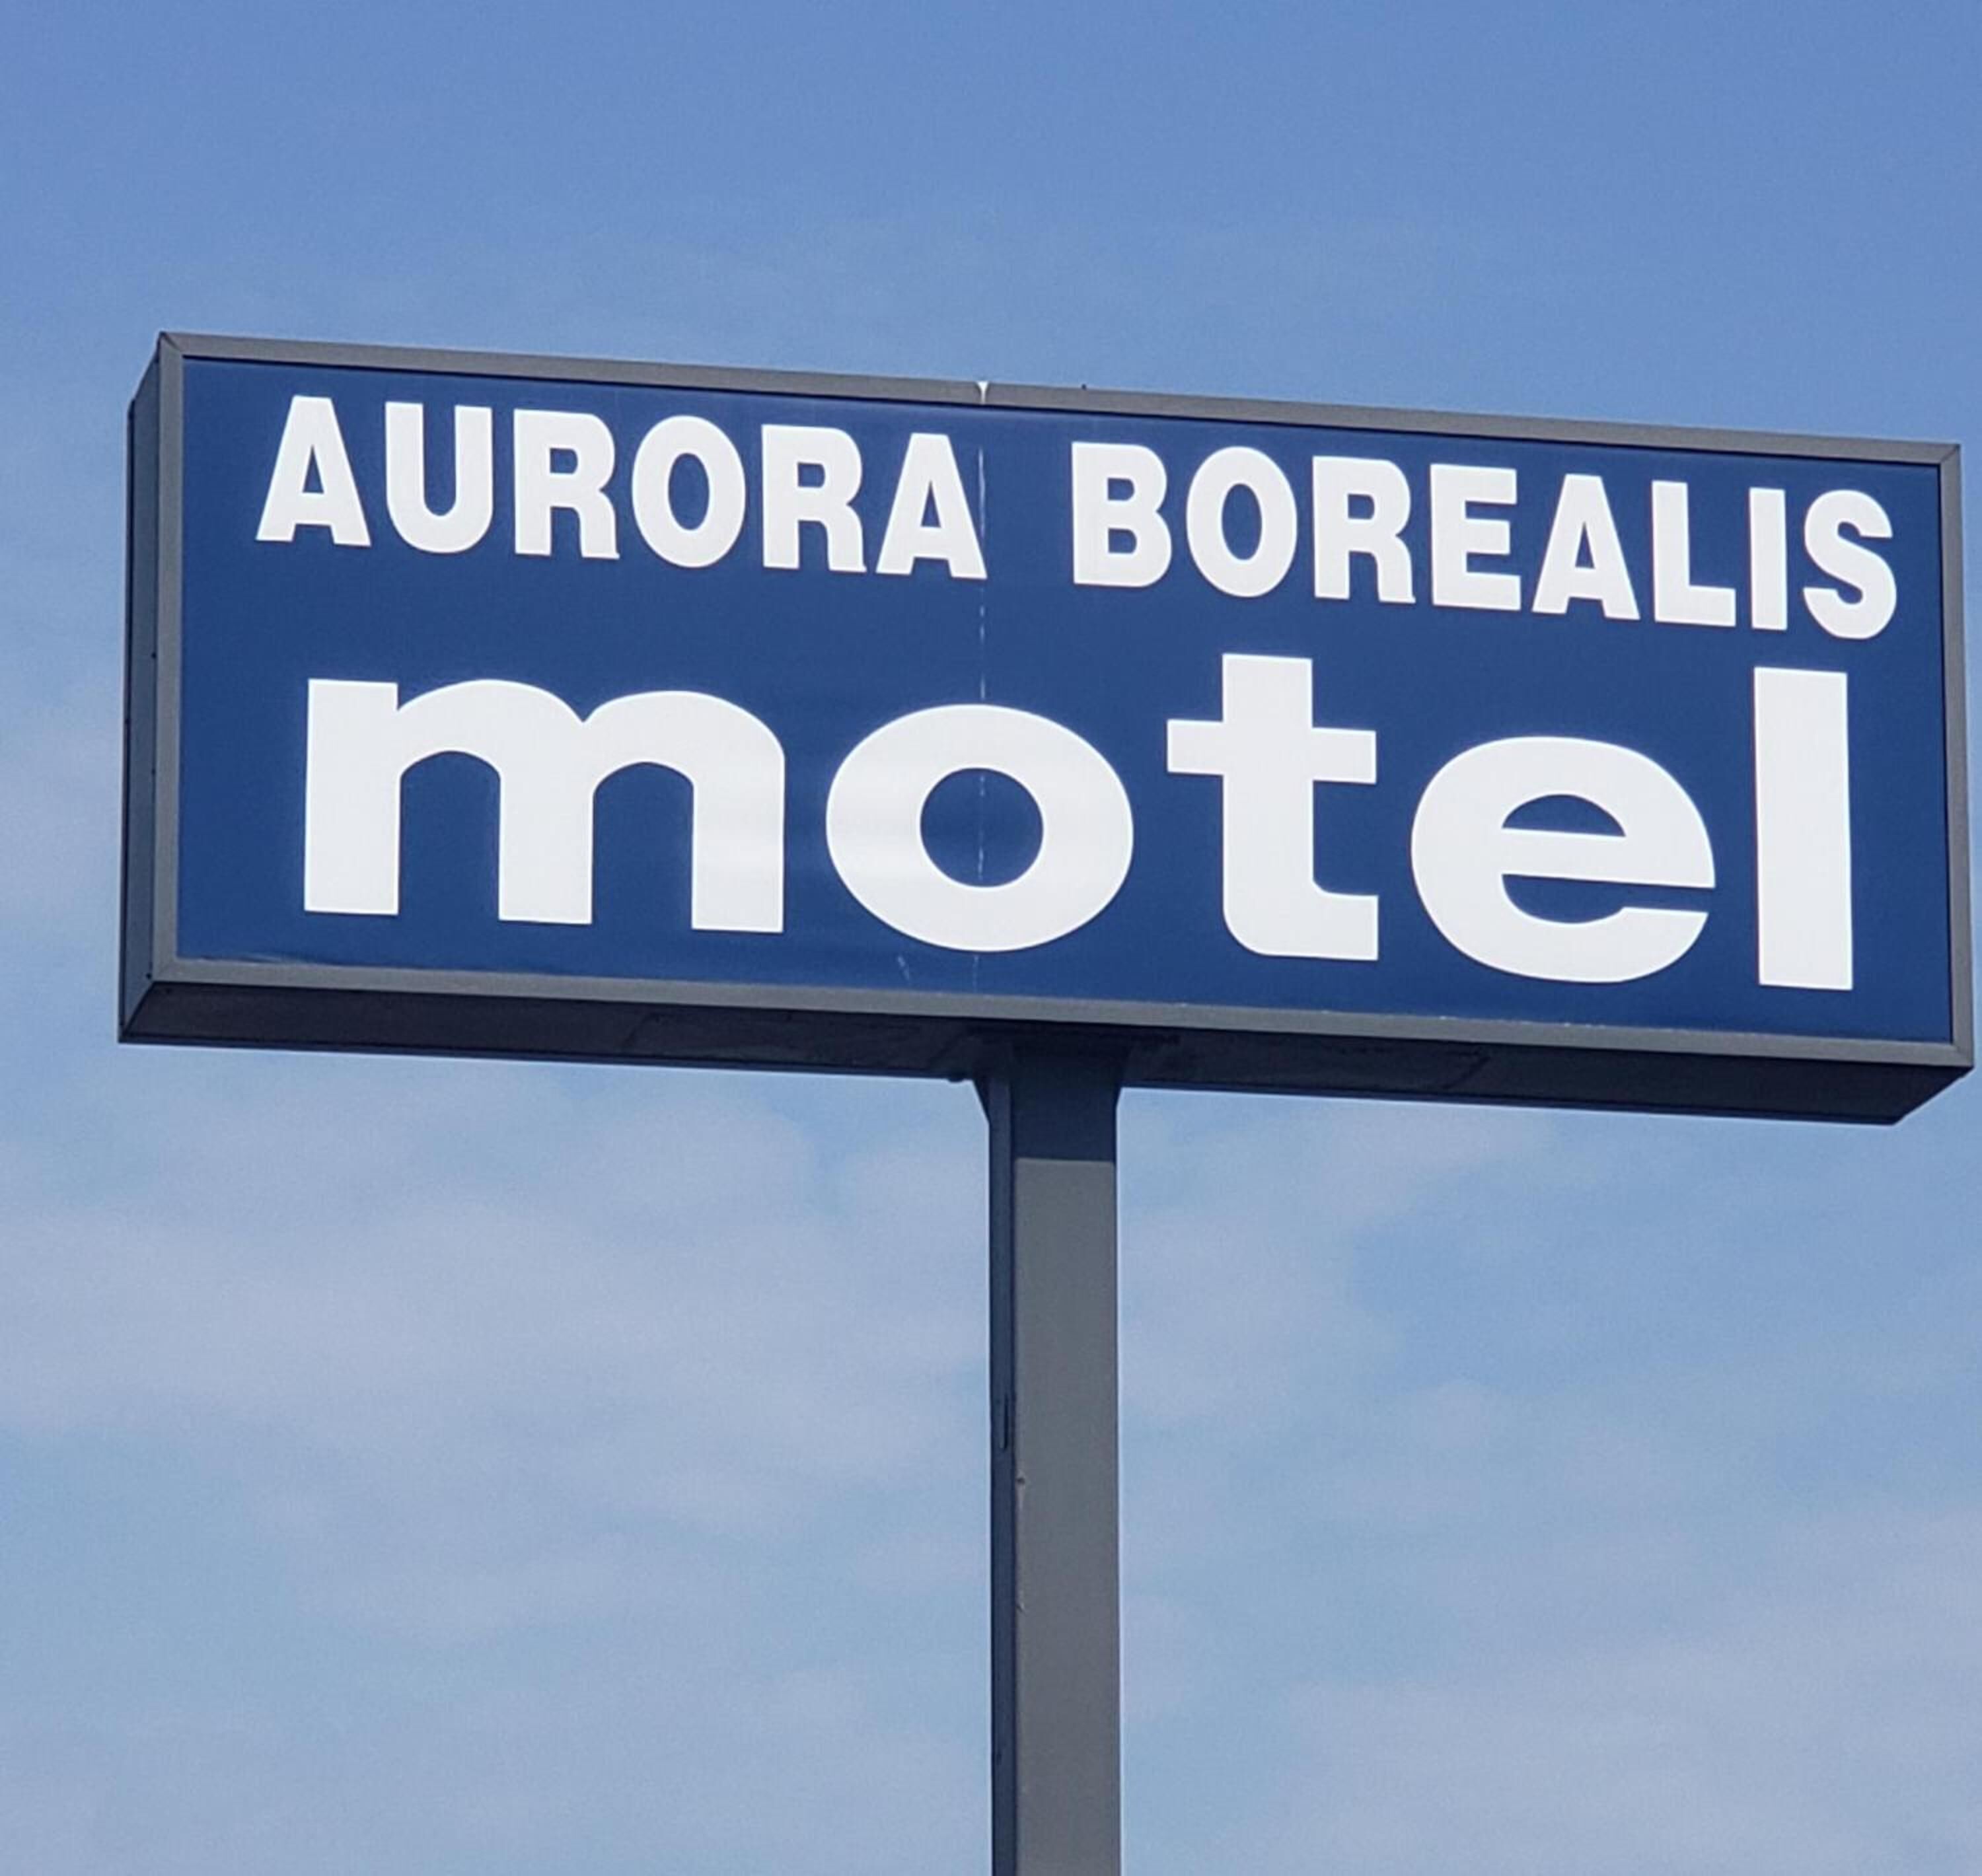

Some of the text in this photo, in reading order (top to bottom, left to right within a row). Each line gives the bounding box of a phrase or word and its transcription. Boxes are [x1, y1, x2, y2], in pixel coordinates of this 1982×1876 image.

[256, 395, 1897, 640] AURORA BOREALIS
[303, 653, 1854, 992] motel
